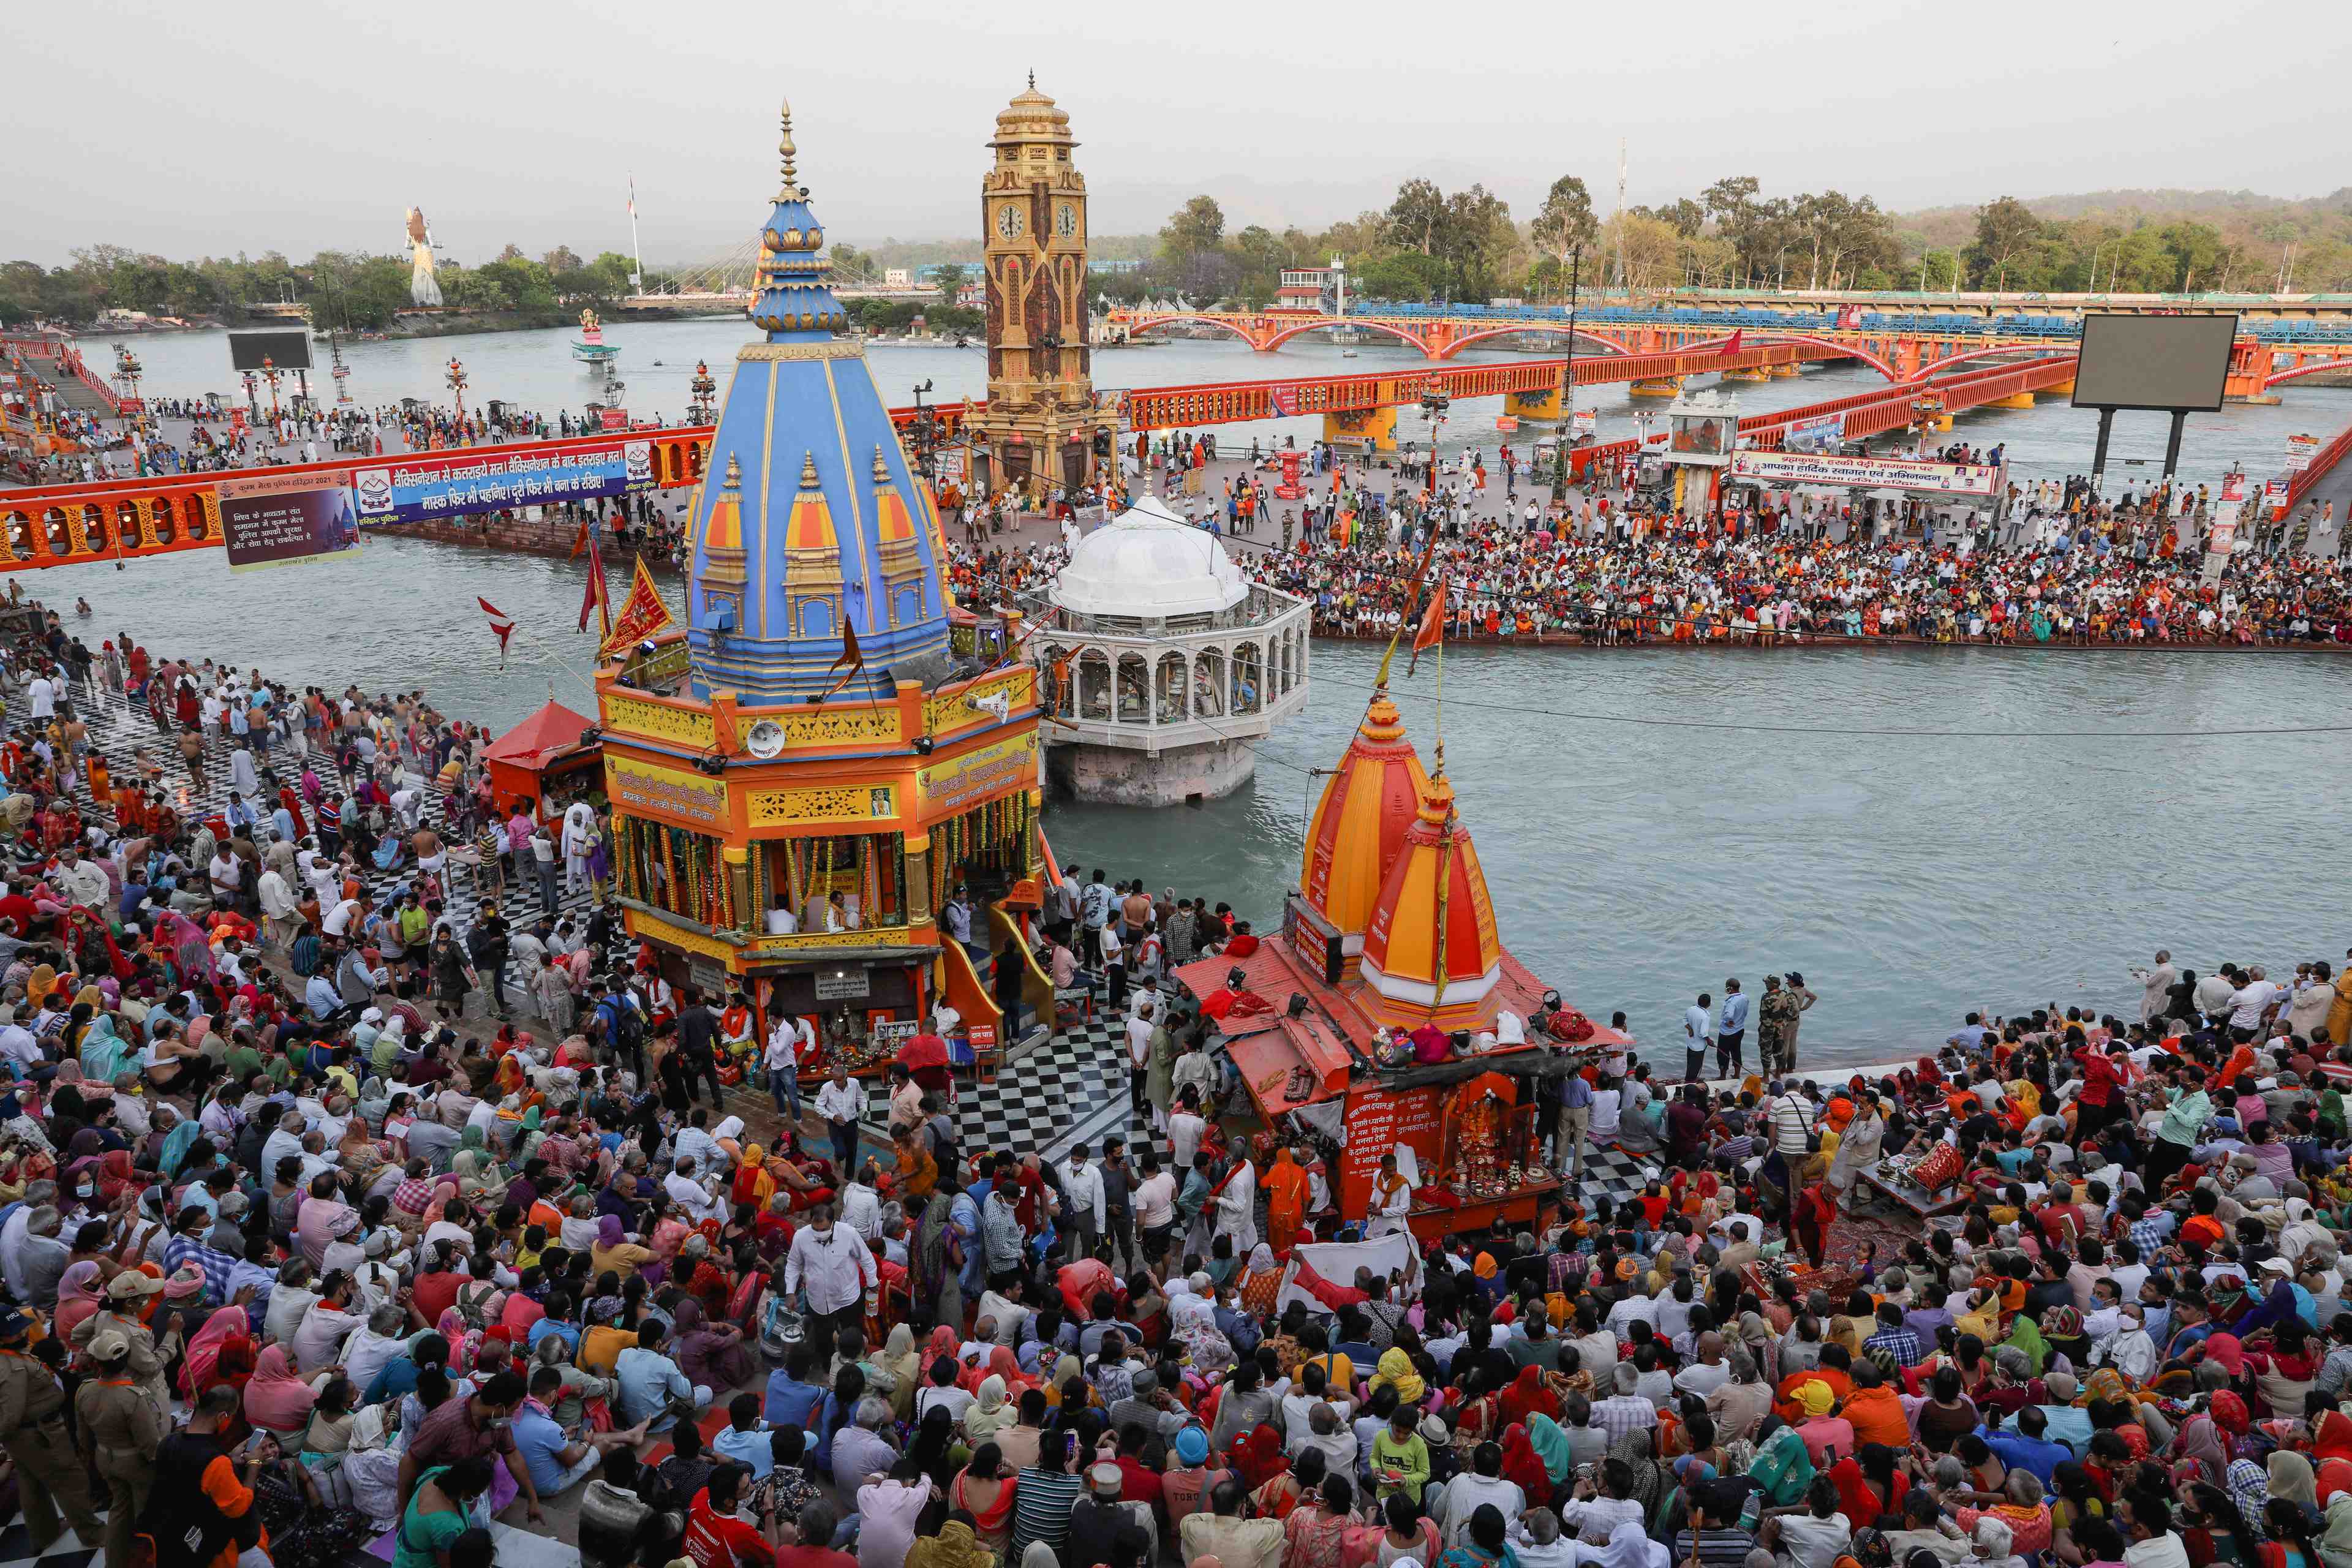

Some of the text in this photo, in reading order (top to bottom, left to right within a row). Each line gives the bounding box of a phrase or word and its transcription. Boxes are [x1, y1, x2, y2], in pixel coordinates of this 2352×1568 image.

[393, 467, 440, 488] वैक्सिनेशन
[442, 465, 451, 482] से
[451, 461, 488, 480] कतराइये
[509, 453, 549, 474] वैक्सिनेशन
[551, 452, 559, 469] के
[561, 456, 576, 469] बाद
[577, 452, 606, 467] इतराइए
[1797, 464, 1828, 473] हार्दिक
[1887, 470, 1940, 481] अभिनन्दन
[274, 479, 290, 491] पुलिस
[291, 478, 315, 488] हरिद्वार
[642, 481, 657, 490] पुलिस
[421, 496, 447, 510] मास्क
[467, 485, 477, 504] भी
[511, 478, 524, 504] दूरी
[543, 476, 553, 494] भी
[554, 478, 569, 492] बना
[571, 475, 579, 491] के
[252, 511, 260, 519] के
[289, 506, 301, 514] संत
[233, 522, 259, 530] समागम
[359, 514, 399, 526] हरिद्वार पुलिस
[238, 526, 302, 542] पुलिस आपकी सुरक्षा
[232, 541, 245, 550] और
[248, 539, 261, 548] सेवा
[264, 538, 275, 547] हेतु
[277, 534, 304, 545] संकल्पित
[1374, 1134, 1387, 1142] देवी
[1355, 1147, 1370, 1155] दर्शन
[1362, 1155, 1376, 1164] भागी
